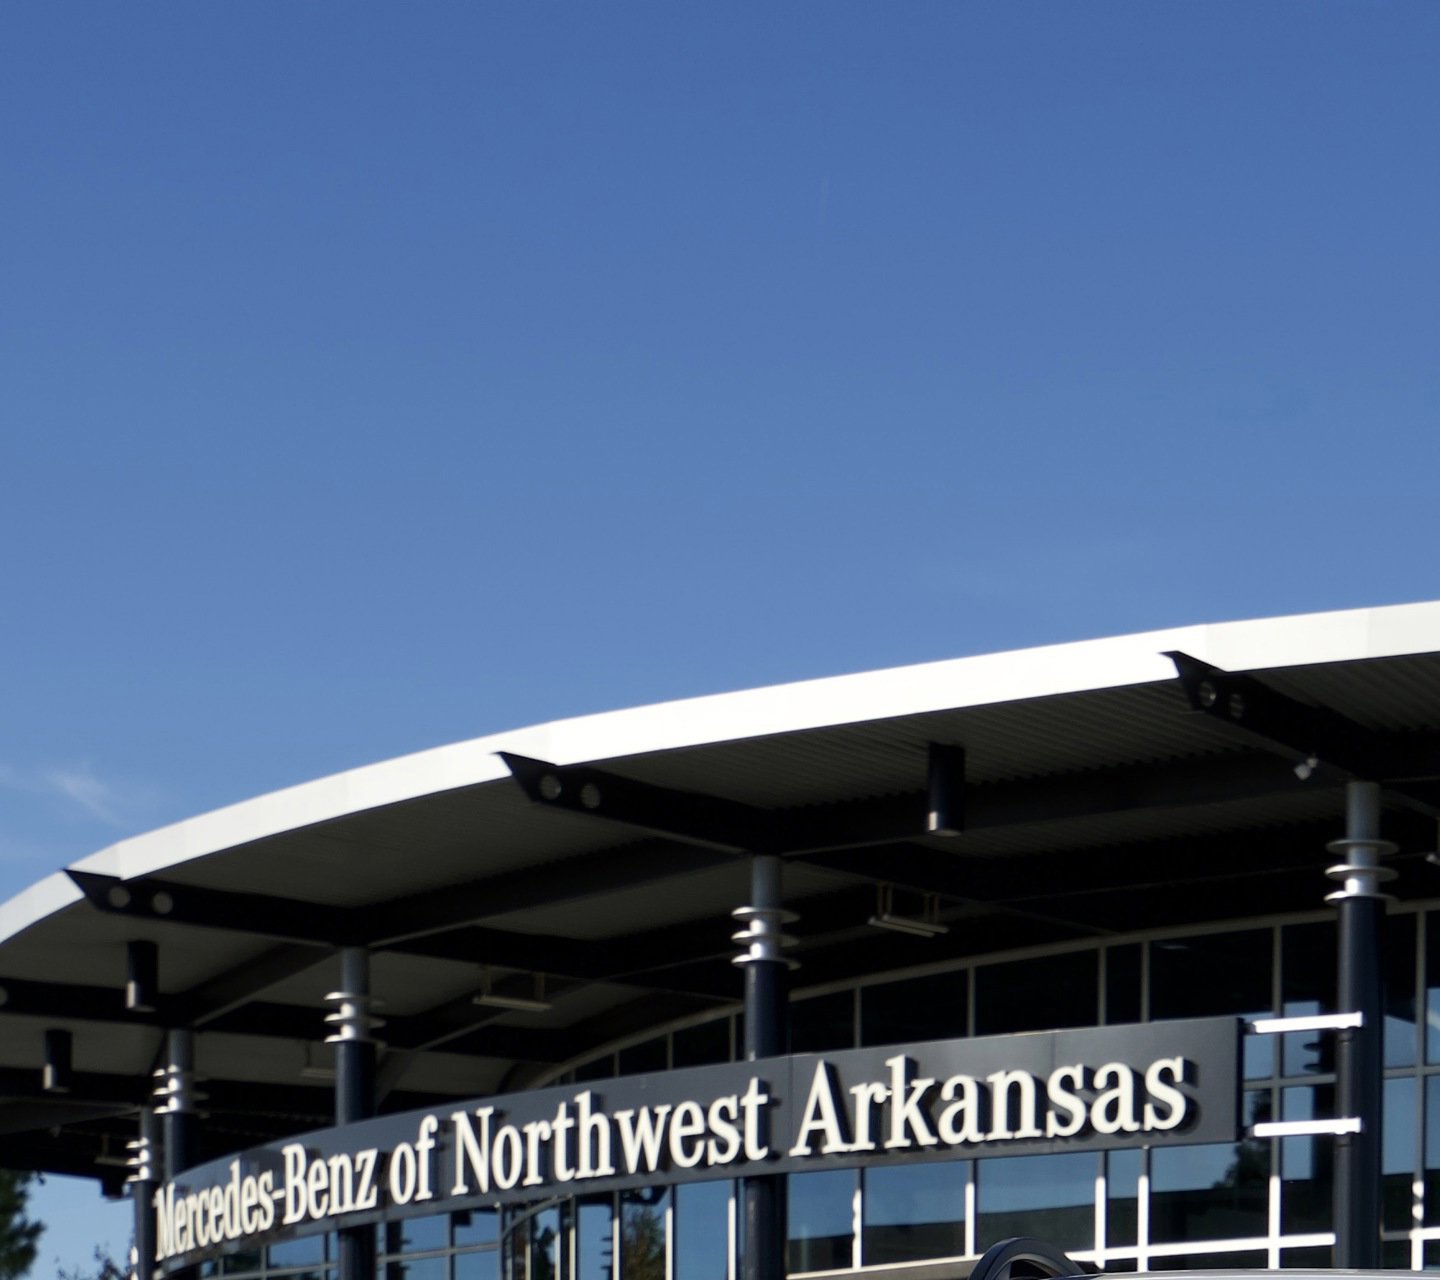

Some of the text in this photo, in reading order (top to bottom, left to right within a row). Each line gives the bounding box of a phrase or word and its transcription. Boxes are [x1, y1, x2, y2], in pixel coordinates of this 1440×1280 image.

[153, 1052, 1188, 1263] Mercedes-Benz of Northwest Arkansas
